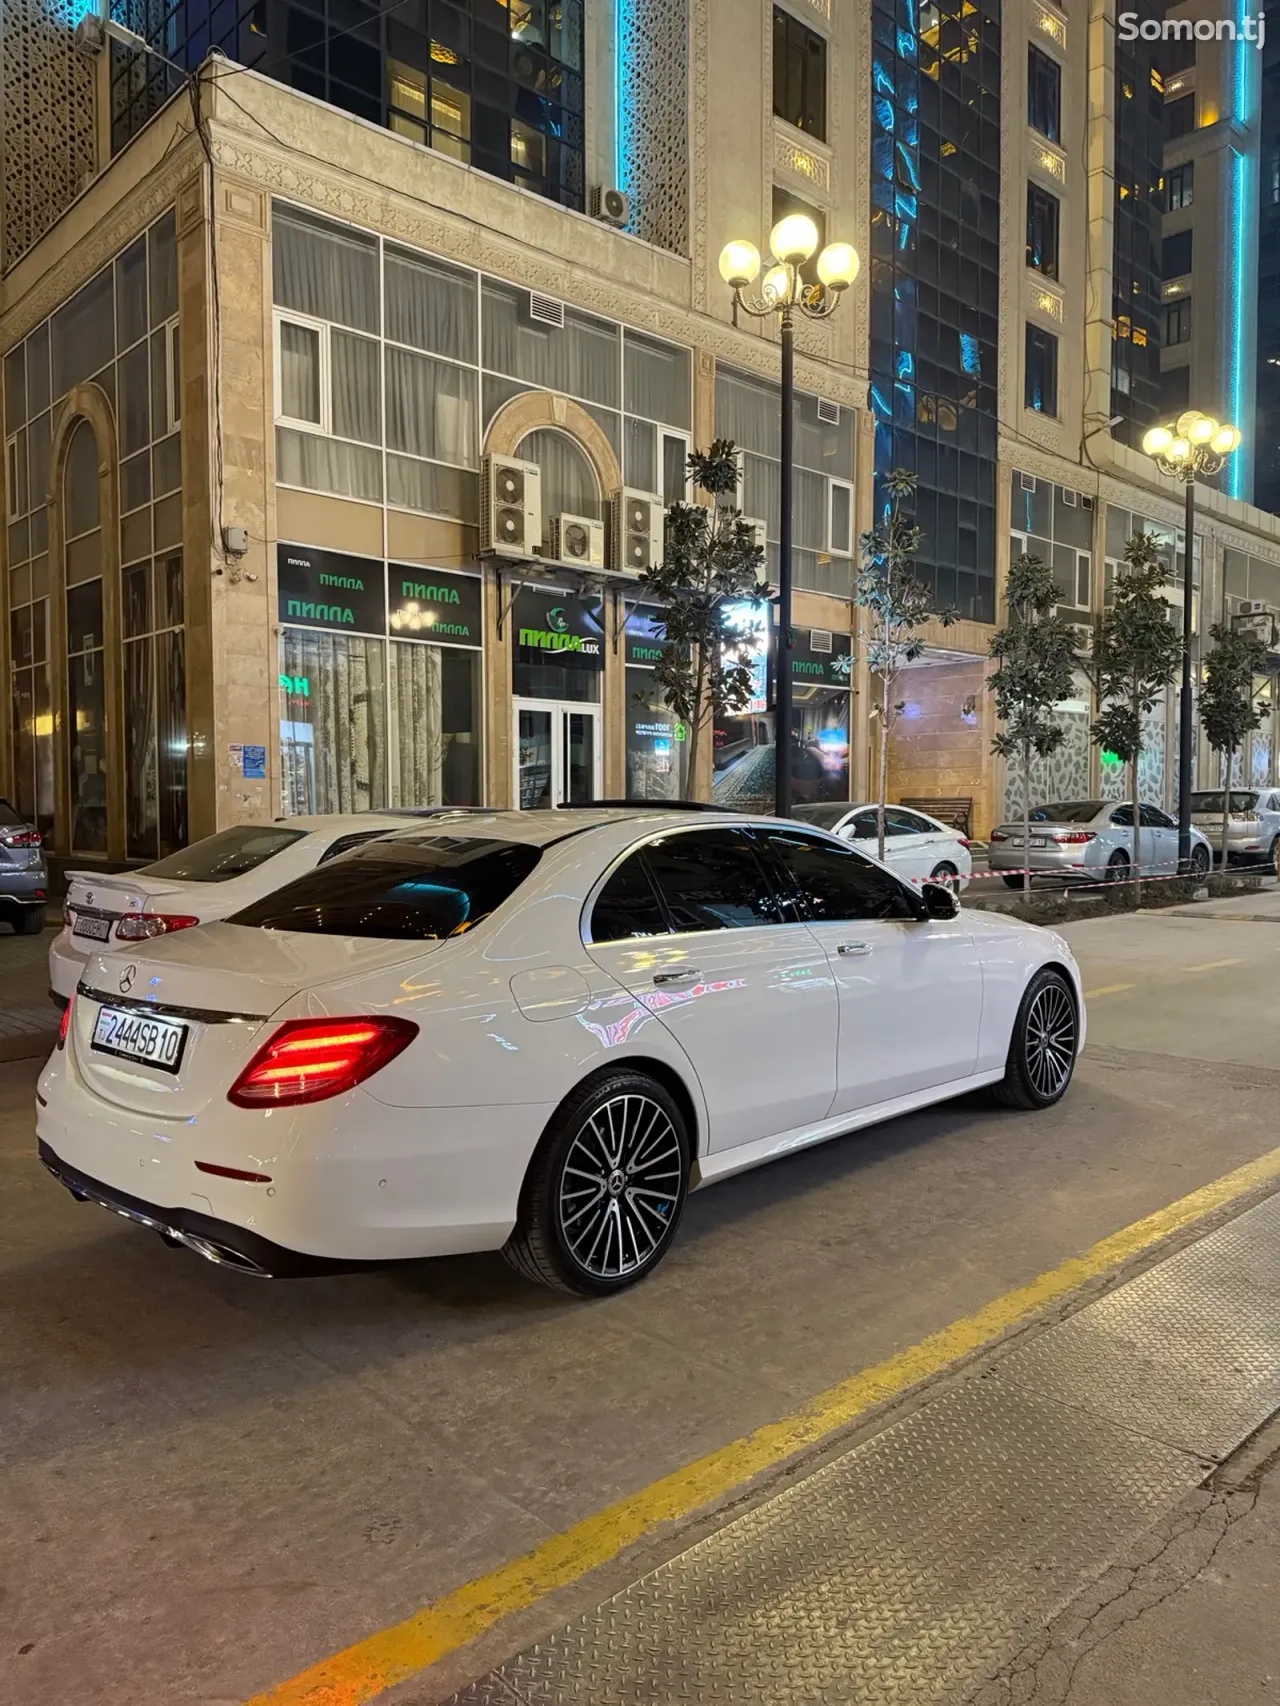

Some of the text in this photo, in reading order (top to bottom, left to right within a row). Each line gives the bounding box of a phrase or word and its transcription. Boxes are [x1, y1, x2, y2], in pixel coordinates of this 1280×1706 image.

[581, 643, 600, 655] LUX
[632, 647, 663, 661] ПИЛЛ
[105, 1015, 179, 1061] 2444SB10
